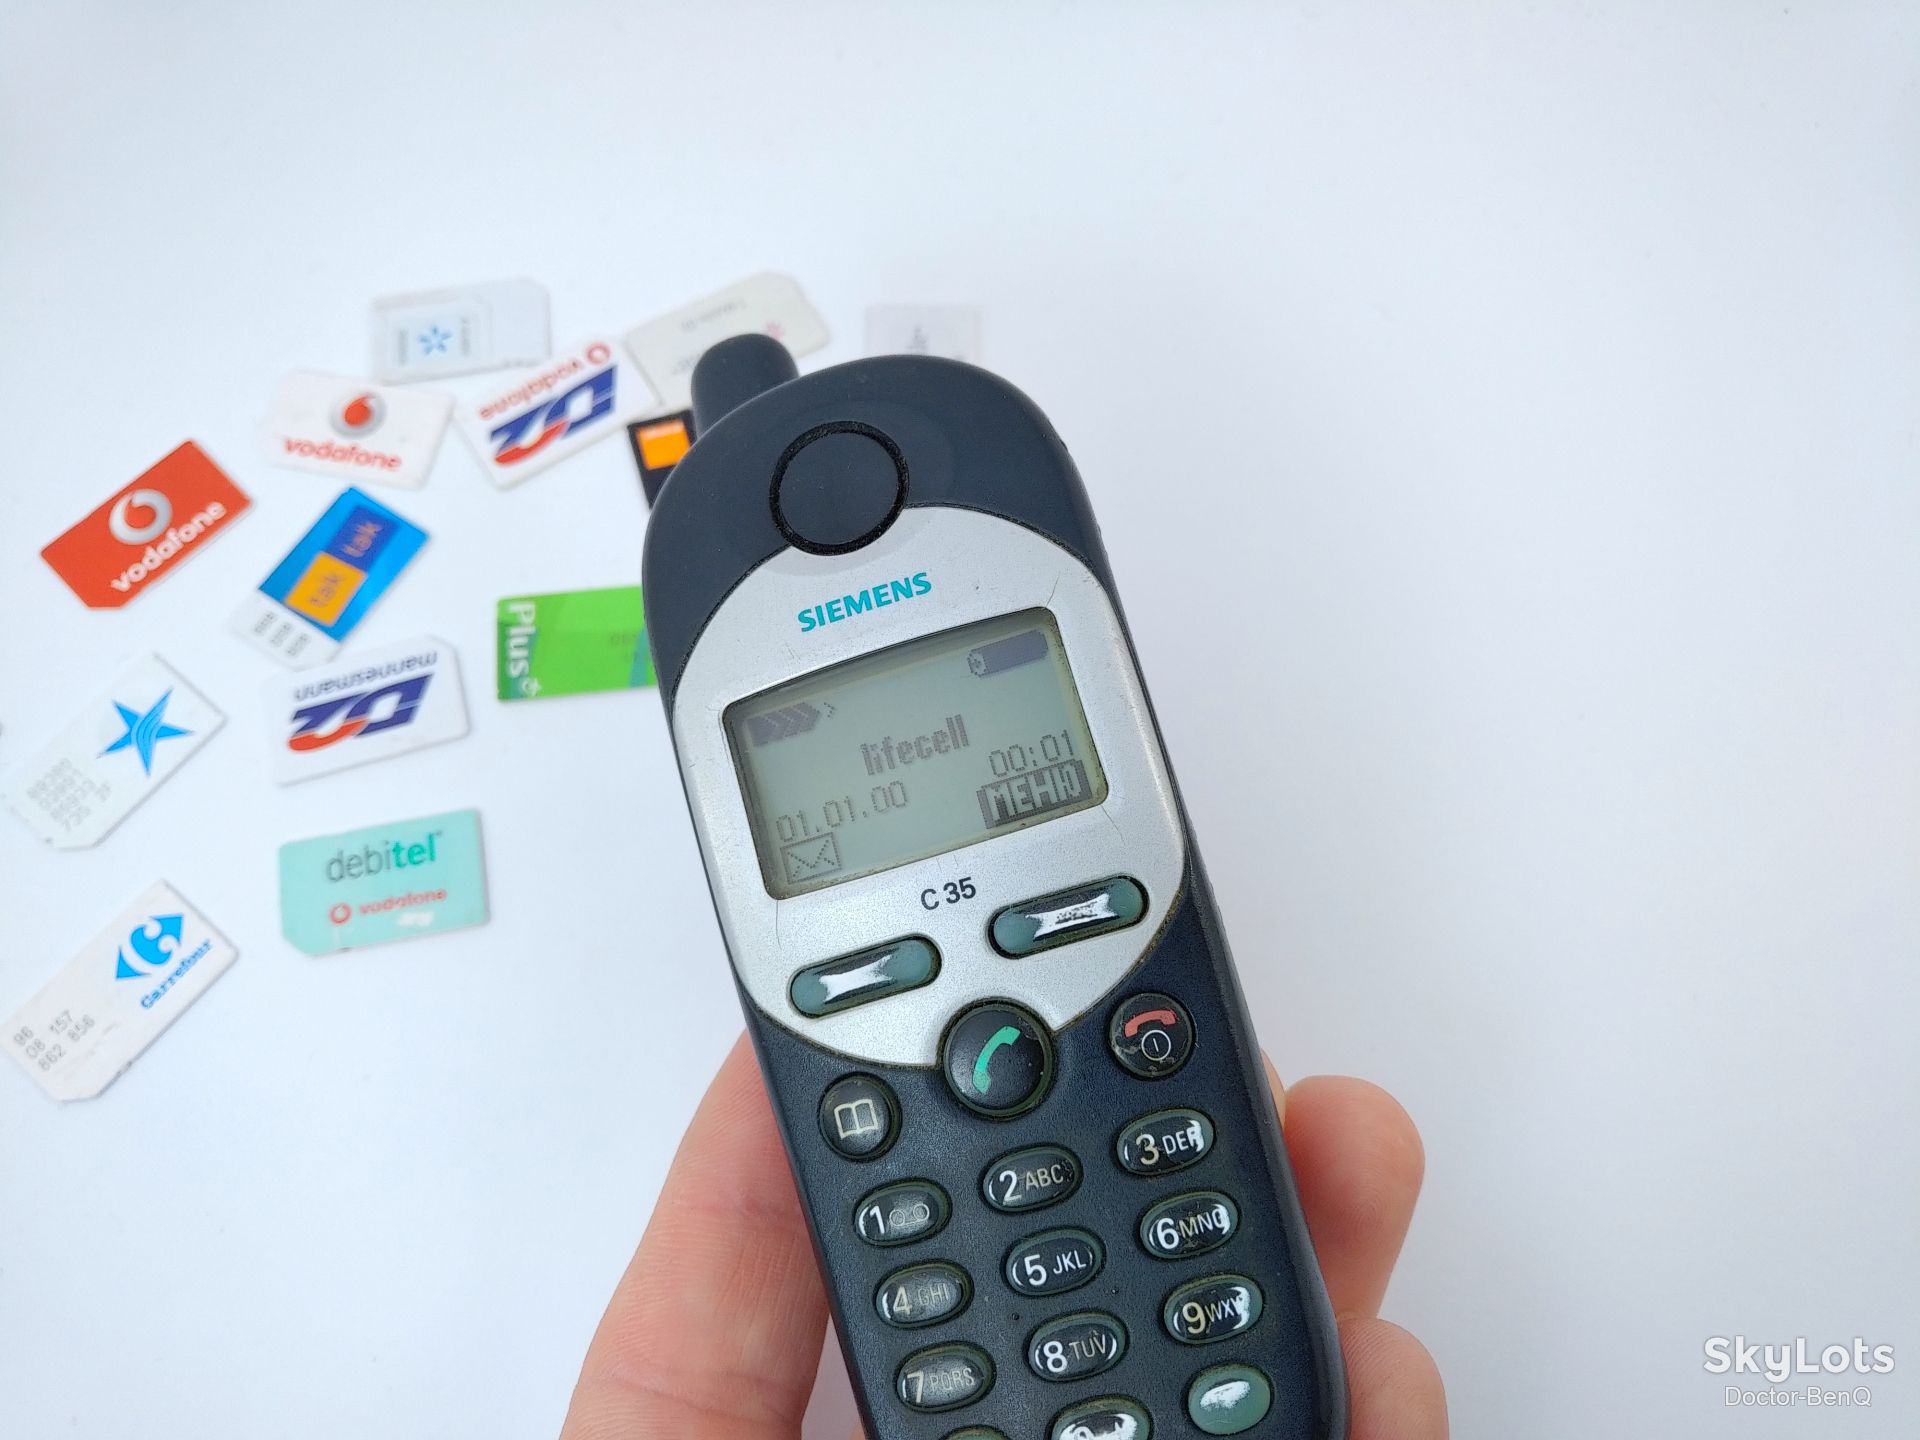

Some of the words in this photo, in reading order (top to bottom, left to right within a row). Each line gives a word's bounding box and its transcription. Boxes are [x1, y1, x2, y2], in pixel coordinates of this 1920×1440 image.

[282, 433, 403, 473] vodafone
[110, 500, 227, 594] vodafone
[797, 571, 932, 633] SIEMENS
[506, 602, 536, 677] Plus
[294, 649, 438, 700] mannesmann
[860, 714, 970, 776] lifecell
[987, 729, 1077, 779] 00:01
[775, 780, 910, 843] 01.01.00
[325, 831, 438, 883] debitel
[358, 886, 448, 915] vodafone
[1135, 1133, 1160, 1165] 3
[999, 1169, 1022, 1205] 2
[1025, 1163, 1064, 1191] ABC
[869, 1205, 886, 1235] 1
[1156, 1217, 1180, 1250] 6
[1023, 1253, 1048, 1286] 5
[1052, 1249, 1087, 1275] JKL
[892, 1285, 913, 1315] 4
[917, 1282, 950, 1306] GHI
[1182, 1301, 1206, 1335] 9
[1043, 1340, 1069, 1373] 8
[1068, 1332, 1106, 1361] TUV
[906, 1369, 925, 1404] 7
[929, 1366, 977, 1392] PQRS
